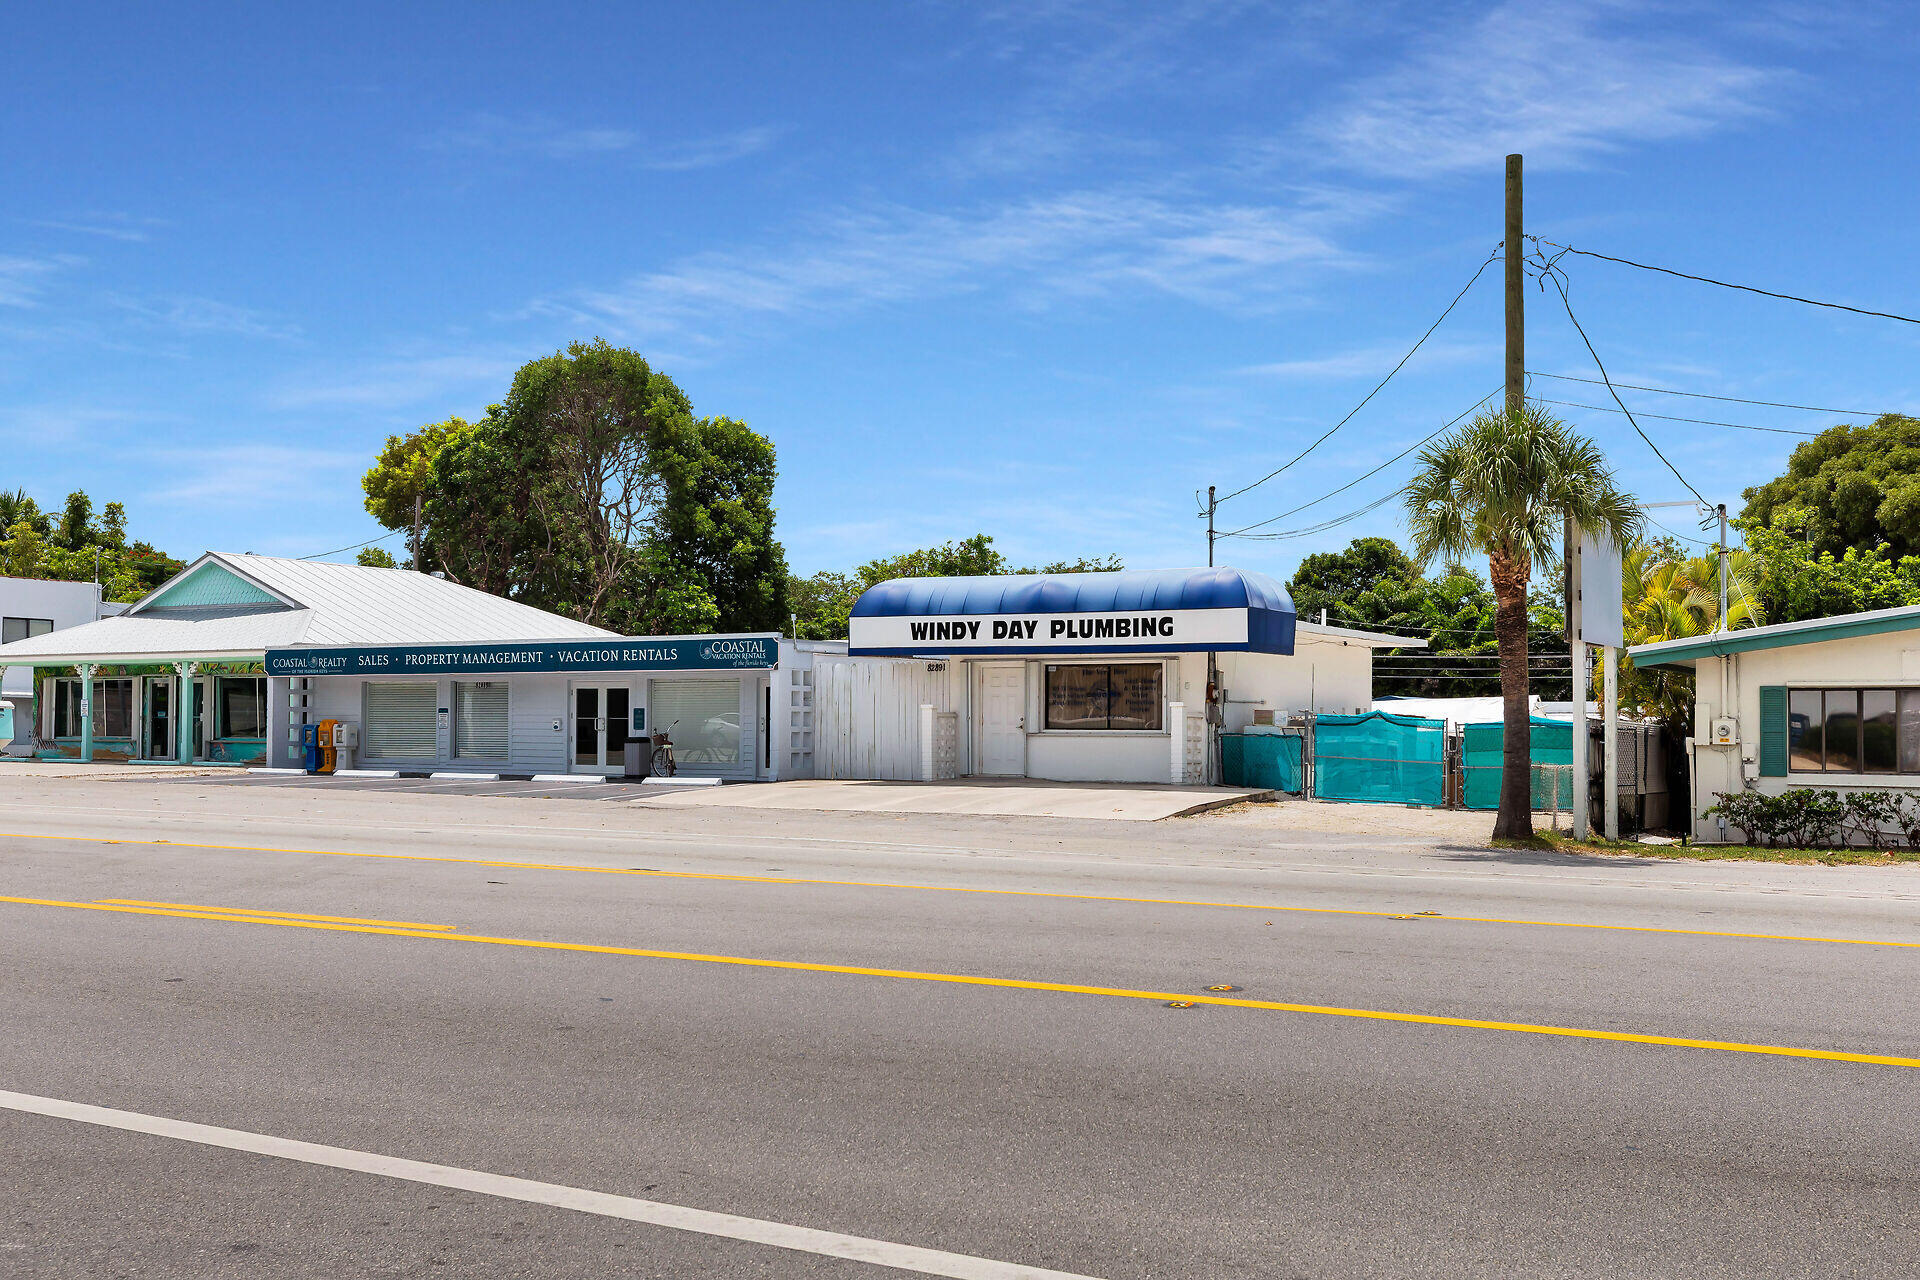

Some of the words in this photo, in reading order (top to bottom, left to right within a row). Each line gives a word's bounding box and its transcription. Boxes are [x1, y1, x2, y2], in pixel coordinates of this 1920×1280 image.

[910, 620, 981, 640] WINDY
[992, 620, 1038, 639] DAY
[1050, 616, 1174, 638] PLUMBING
[711, 640, 766, 653] COASTAL
[358, 654, 389, 666] SALES
[405, 653, 460, 665] PROPERTY
[462, 651, 544, 664] MANAGEMENT
[558, 650, 619, 662] VACATION
[623, 648, 678, 661] RENTALS
[711, 652, 741, 660] VACATION
[272, 658, 308, 668] COASTAL
[318, 657, 347, 669] REALTY
[927, 663, 946, 672] 82891
